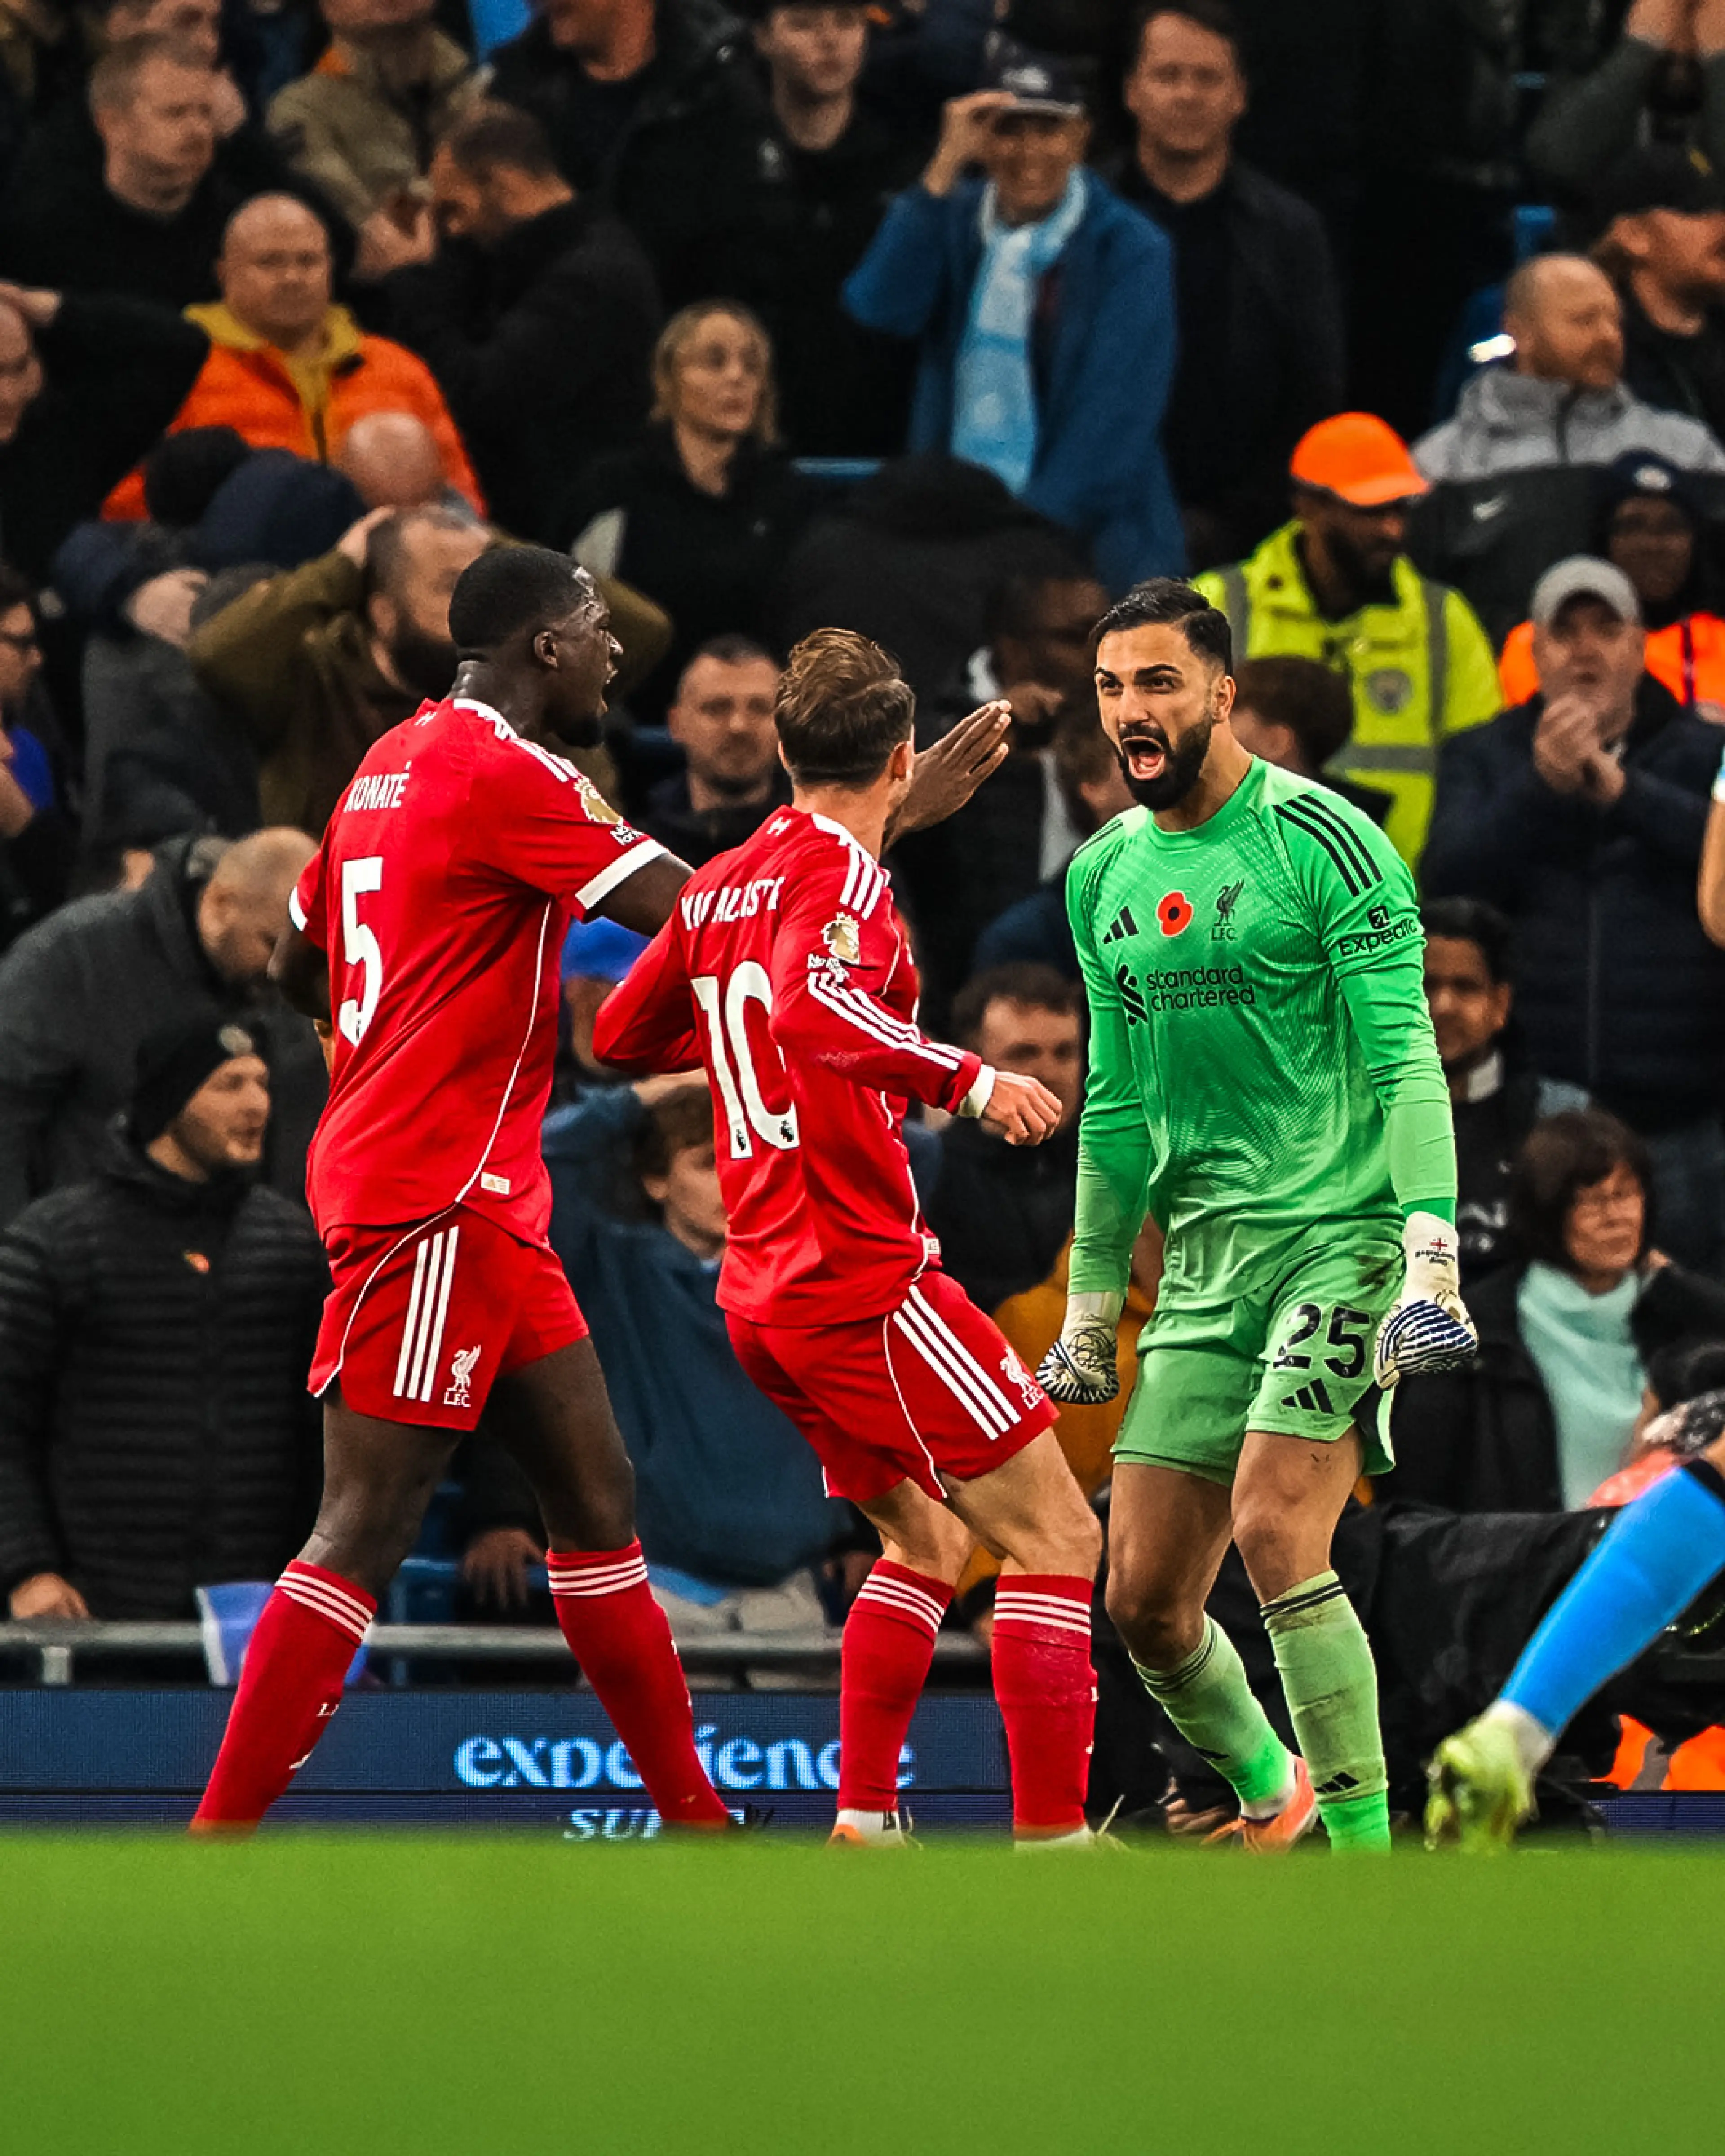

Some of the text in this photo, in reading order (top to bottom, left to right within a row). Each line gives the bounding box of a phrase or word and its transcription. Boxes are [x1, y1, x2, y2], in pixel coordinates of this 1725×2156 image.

[339, 856, 383, 1047] 5
[1212, 928, 1238, 941] LFC
[1146, 965, 1243, 991] standard
[1151, 985, 1255, 1012] chartered
[690, 959, 801, 1159] 10
[1273, 1303, 1370, 1378] 25
[443, 1392, 472, 1408] LFC
[453, 1724, 918, 1789] expeienc
